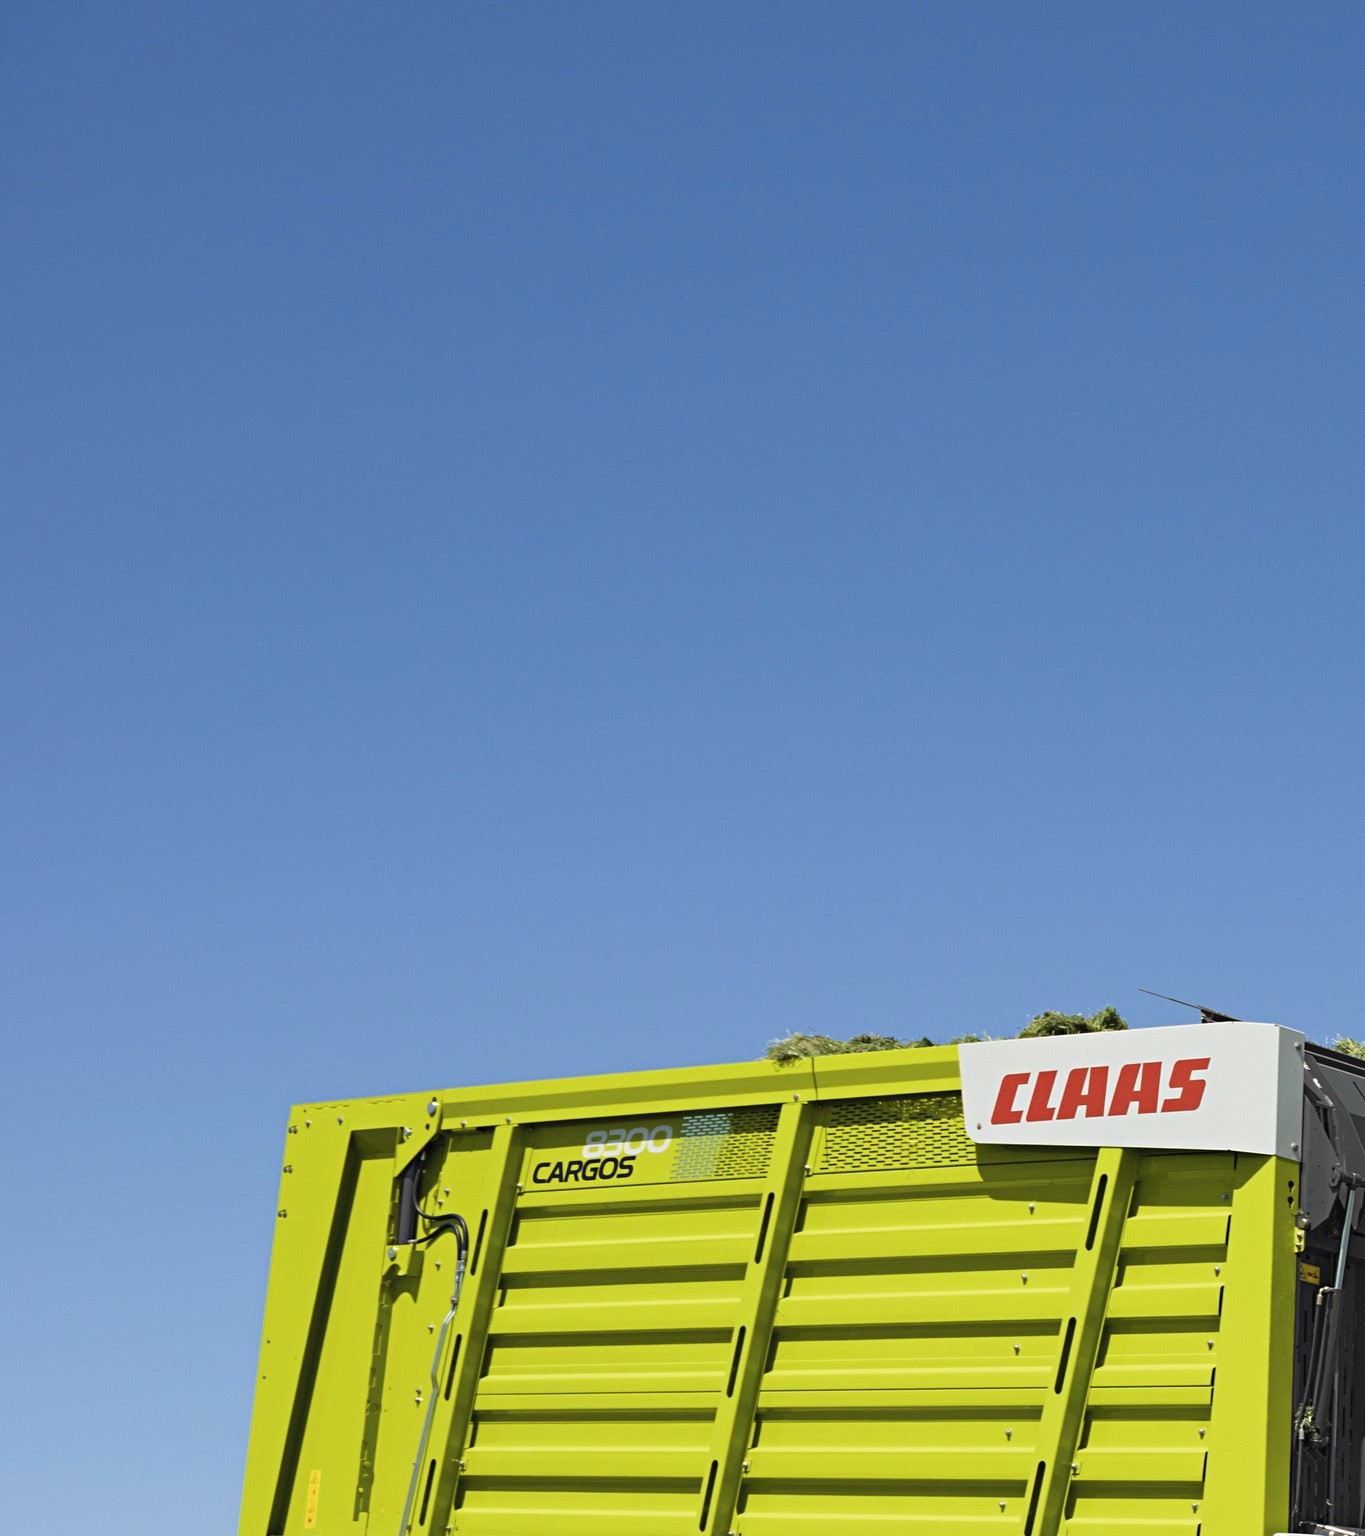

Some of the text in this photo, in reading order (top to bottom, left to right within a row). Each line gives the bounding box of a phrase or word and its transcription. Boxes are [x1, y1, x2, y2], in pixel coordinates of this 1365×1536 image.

[991, 1057, 1211, 1125] CLAAS
[582, 1125, 673, 1159] 8300
[532, 1156, 636, 1184] CARGOS
